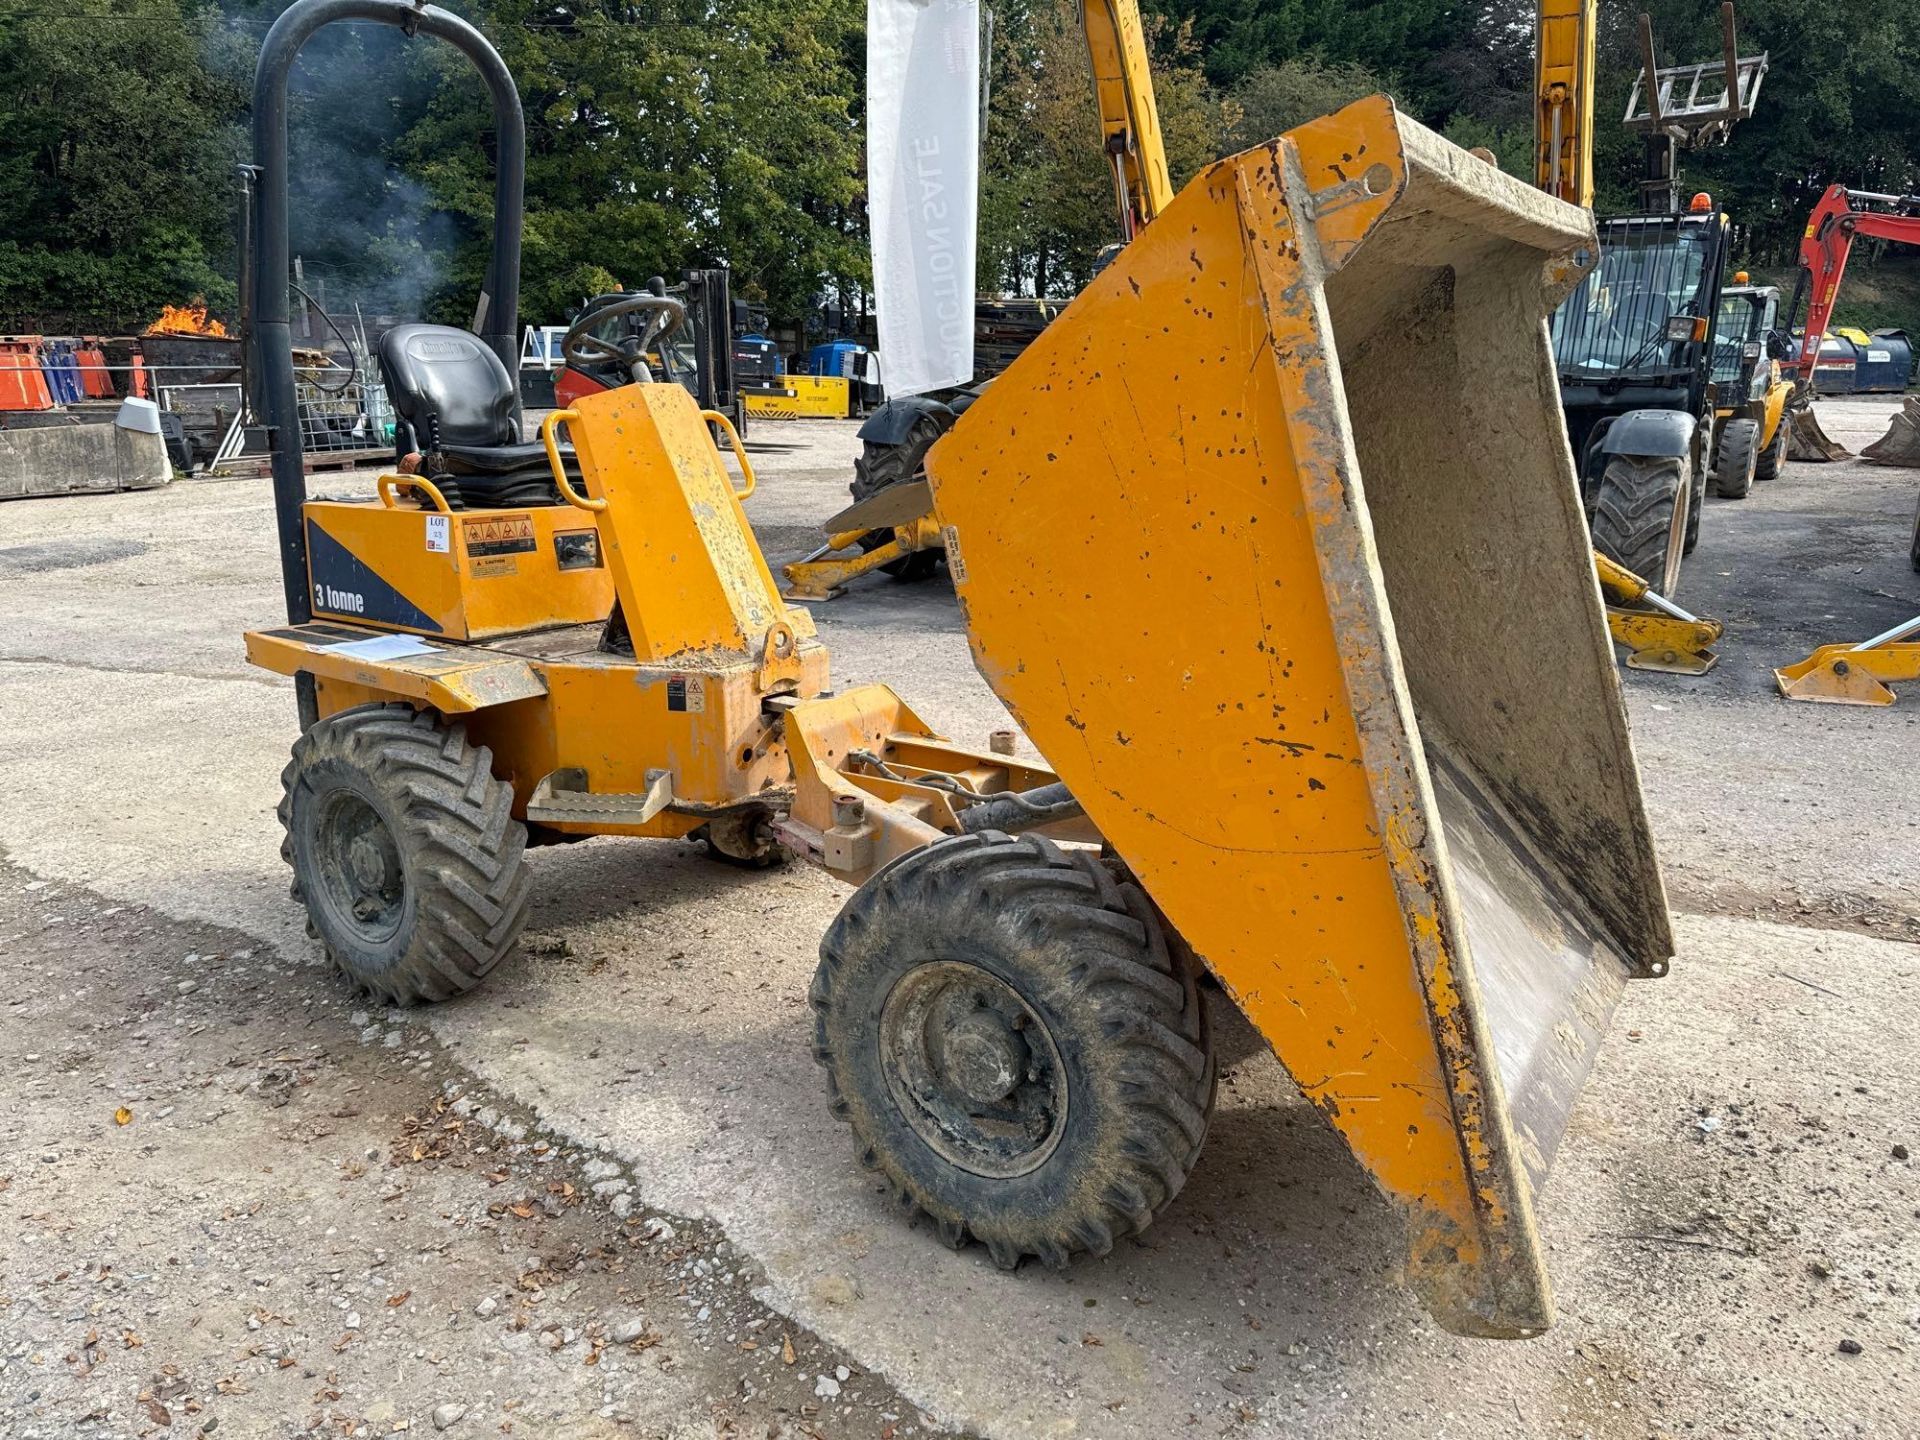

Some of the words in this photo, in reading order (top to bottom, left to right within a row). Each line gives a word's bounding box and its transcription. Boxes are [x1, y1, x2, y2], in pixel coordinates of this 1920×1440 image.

[430, 517, 444, 527] LOT
[315, 584, 324, 607] 3
[326, 585, 364, 613] tonne
